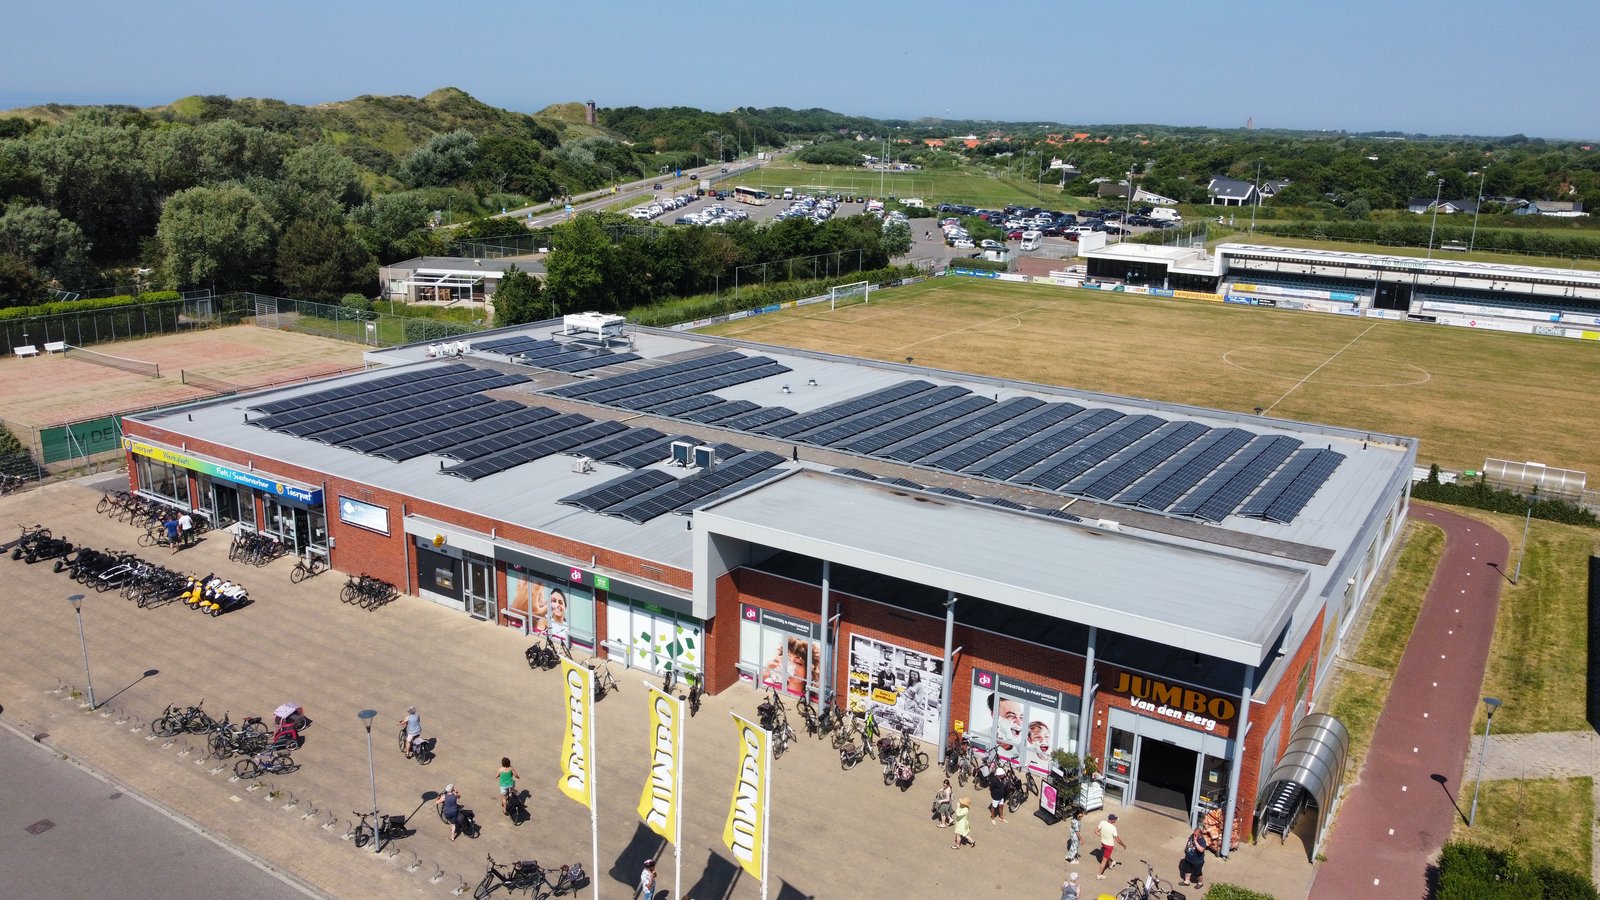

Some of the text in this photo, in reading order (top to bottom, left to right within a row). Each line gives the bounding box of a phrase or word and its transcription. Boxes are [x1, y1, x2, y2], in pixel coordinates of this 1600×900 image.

[92, 427, 113, 443] DE
[286, 487, 312, 501] Toerpunt
[571, 569, 581, 580] da
[747, 609, 756, 618] da
[979, 675, 991, 684] da
[1030, 689, 1058, 701] PARFUMERIE
[1114, 672, 1235, 720] JUMBO
[1130, 695, 1216, 730] Van den Berg
[646, 696, 673, 829] JUMBO
[730, 726, 761, 862] JUMBO
